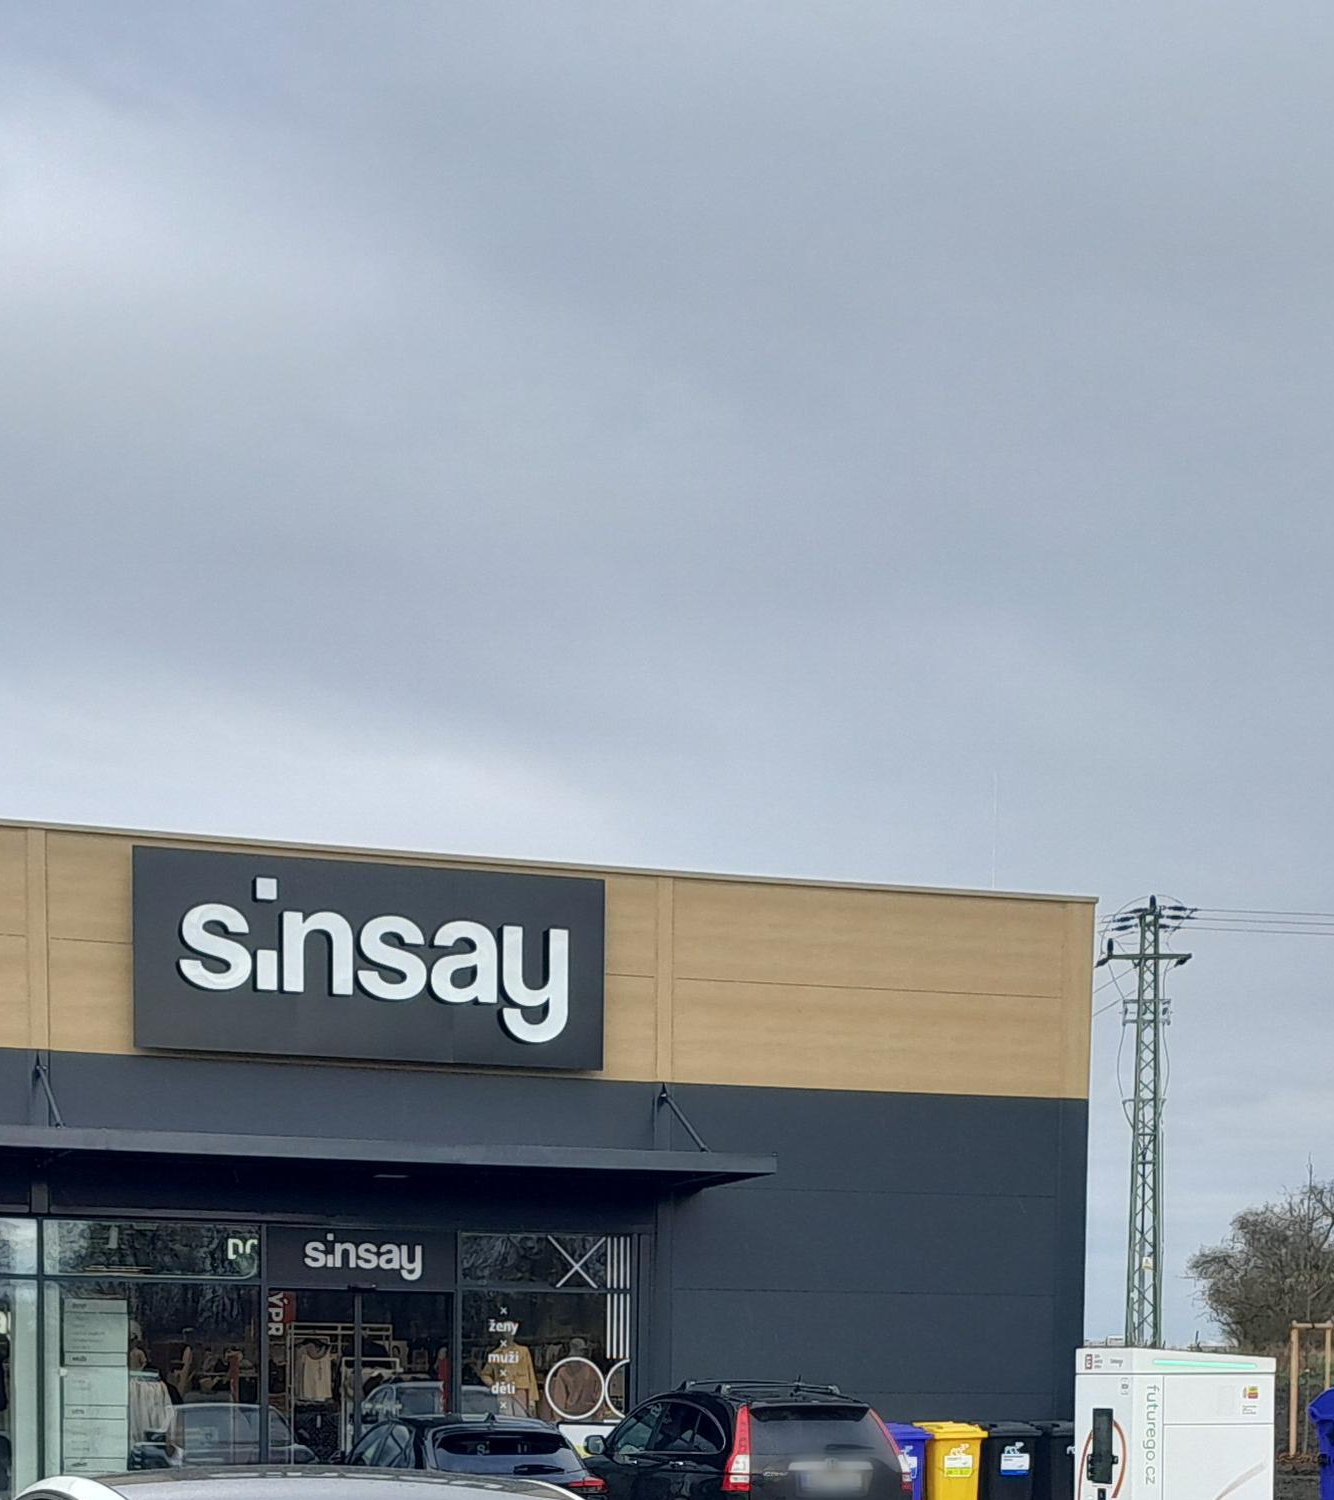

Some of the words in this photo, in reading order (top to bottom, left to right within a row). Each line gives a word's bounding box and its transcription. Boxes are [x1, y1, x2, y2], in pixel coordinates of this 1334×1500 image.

[178, 877, 569, 1044] sinsay
[304, 1233, 423, 1281] sinsay
[488, 1319, 519, 1335] ženy
[488, 1352, 519, 1363] muži
[1143, 1384, 1160, 1485] futurego.cz
